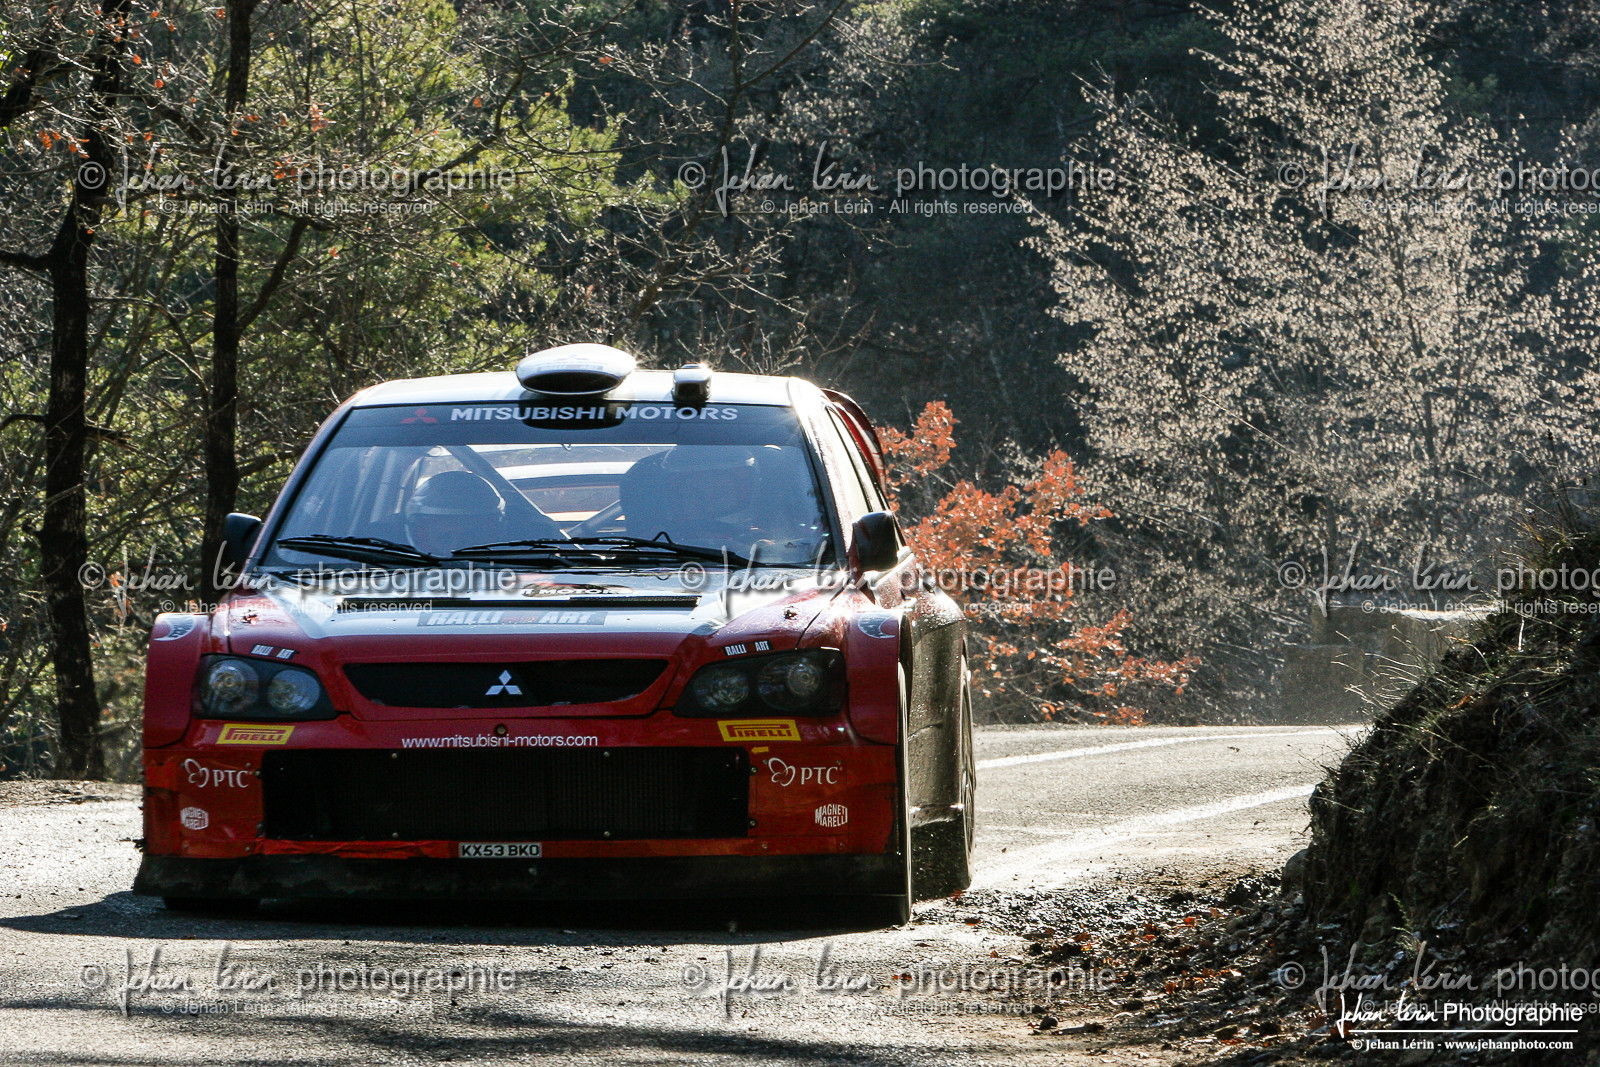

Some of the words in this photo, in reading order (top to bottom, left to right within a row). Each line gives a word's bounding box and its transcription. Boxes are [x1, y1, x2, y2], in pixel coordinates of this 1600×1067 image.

[451, 406, 605, 421] MITSUBISHI
[615, 406, 739, 421] MOTORS
[426, 610, 502, 626] RALLI
[538, 610, 593, 625] ART
[725, 643, 748, 656] RALLI
[755, 640, 770, 652] ART
[225, 727, 287, 741] PIRELLI
[726, 724, 793, 738] PIRELLI
[401, 734, 598, 748] www.mitsubishi-motors.com
[212, 769, 249, 788] PTC
[800, 766, 838, 785] PTC
[815, 803, 848, 816] MAGNETI
[815, 815, 848, 828] MARELLI
[461, 844, 505, 856] KX53
